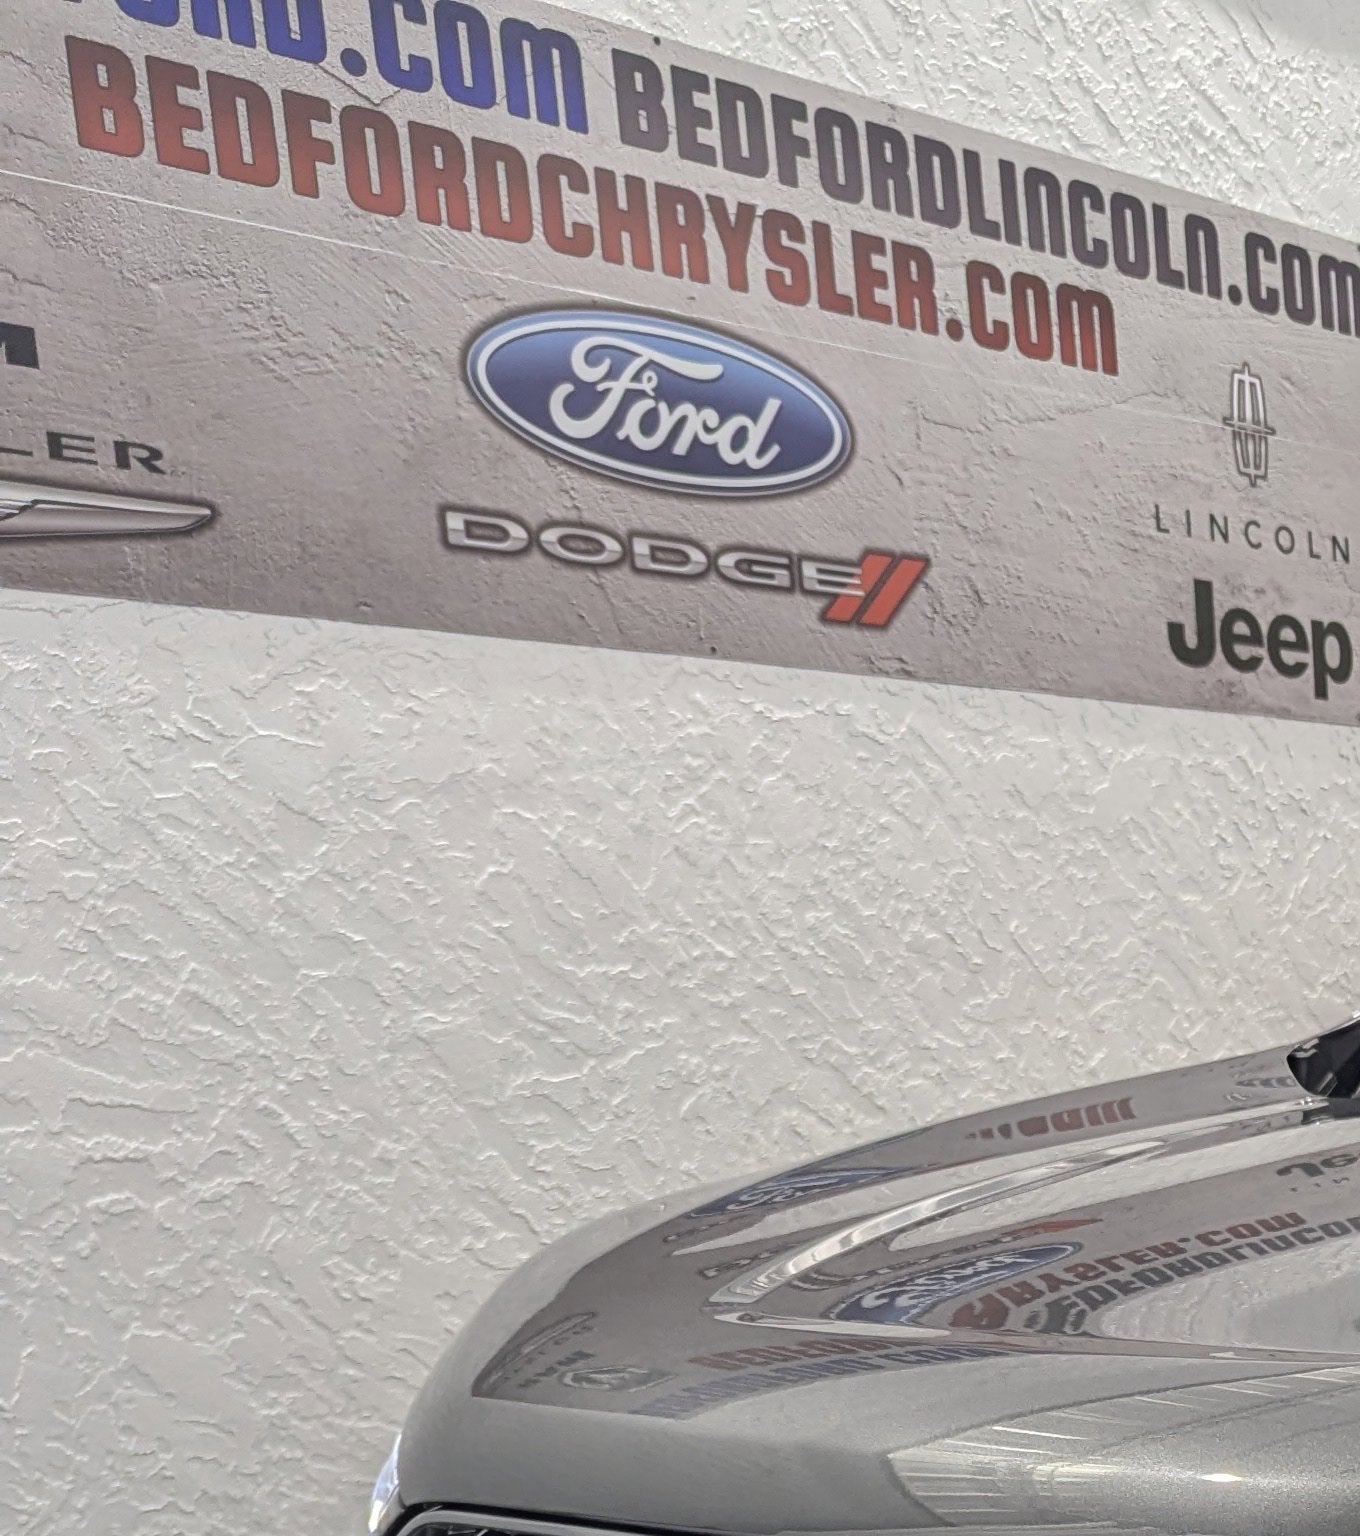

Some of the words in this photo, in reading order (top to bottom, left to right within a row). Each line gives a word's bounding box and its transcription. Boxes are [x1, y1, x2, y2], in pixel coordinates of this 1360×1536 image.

[64, 34, 1119, 377] BEDFORDCHRYSLER.COM
[549, 335, 783, 470] Ford
[444, 509, 866, 597] DODGE
[1154, 503, 1350, 564] LINCOLN
[1166, 577, 1354, 701] Jeep
